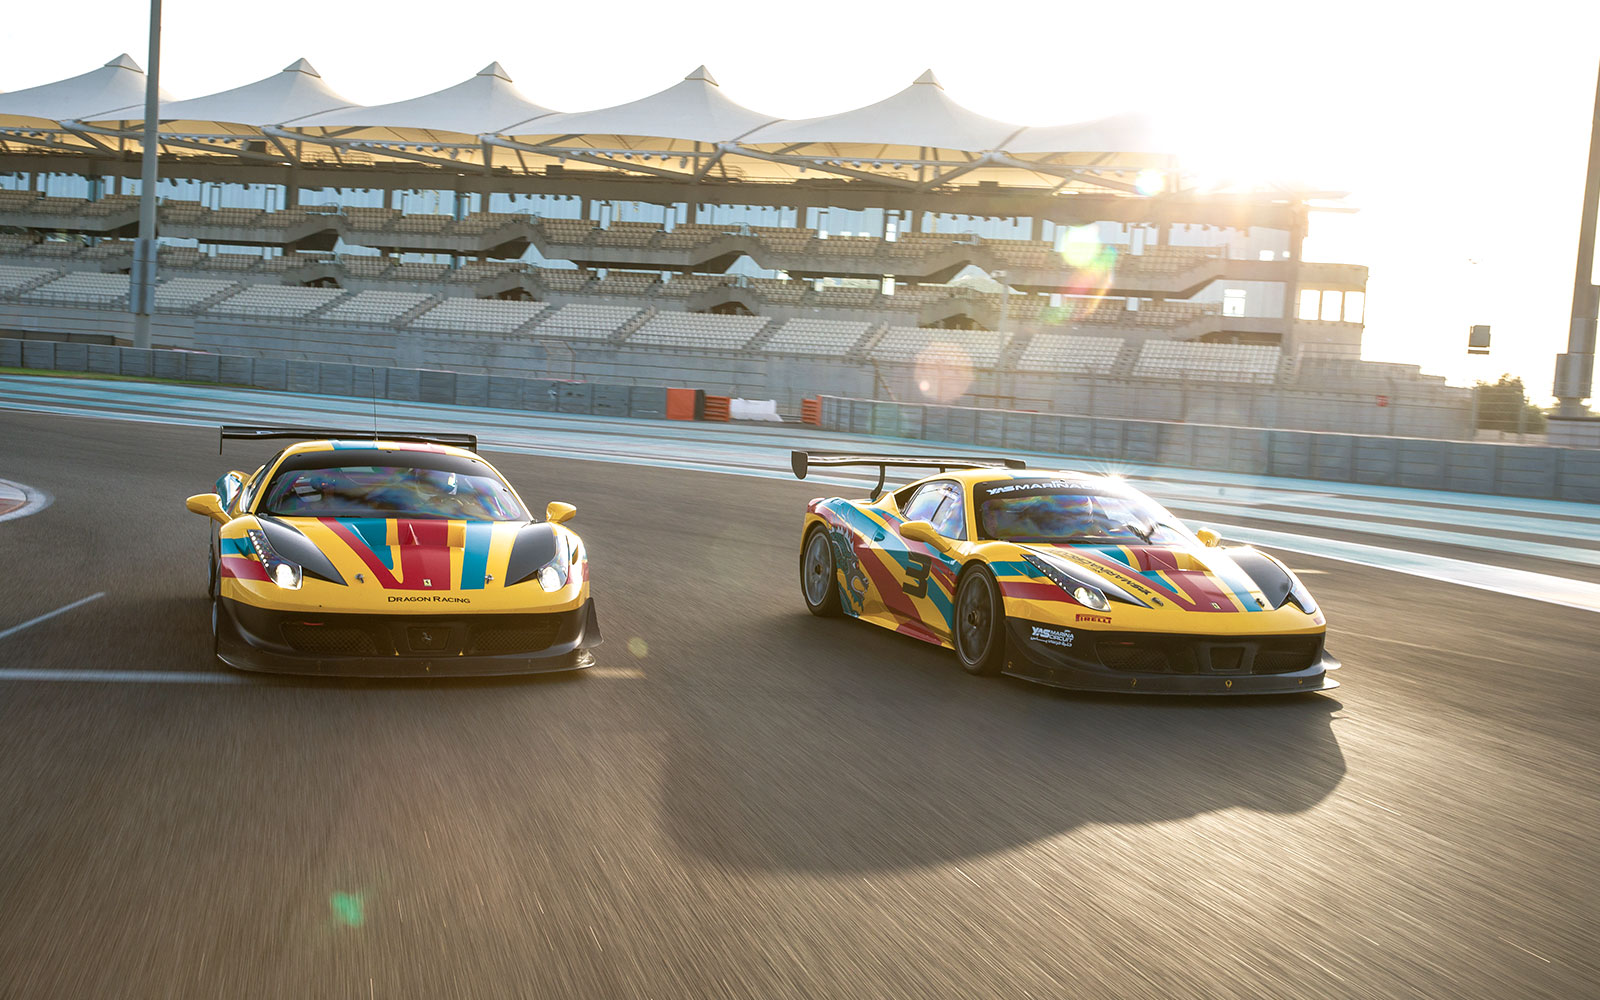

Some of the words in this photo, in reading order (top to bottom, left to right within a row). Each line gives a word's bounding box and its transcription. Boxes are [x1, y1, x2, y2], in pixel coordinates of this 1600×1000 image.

[902, 551, 932, 599] 3
[1075, 614, 1112, 624] PIRELLI
[1031, 626, 1051, 638] YAS
[1050, 630, 1074, 639] MARINA
[1049, 634, 1073, 643] CIRCUIT
